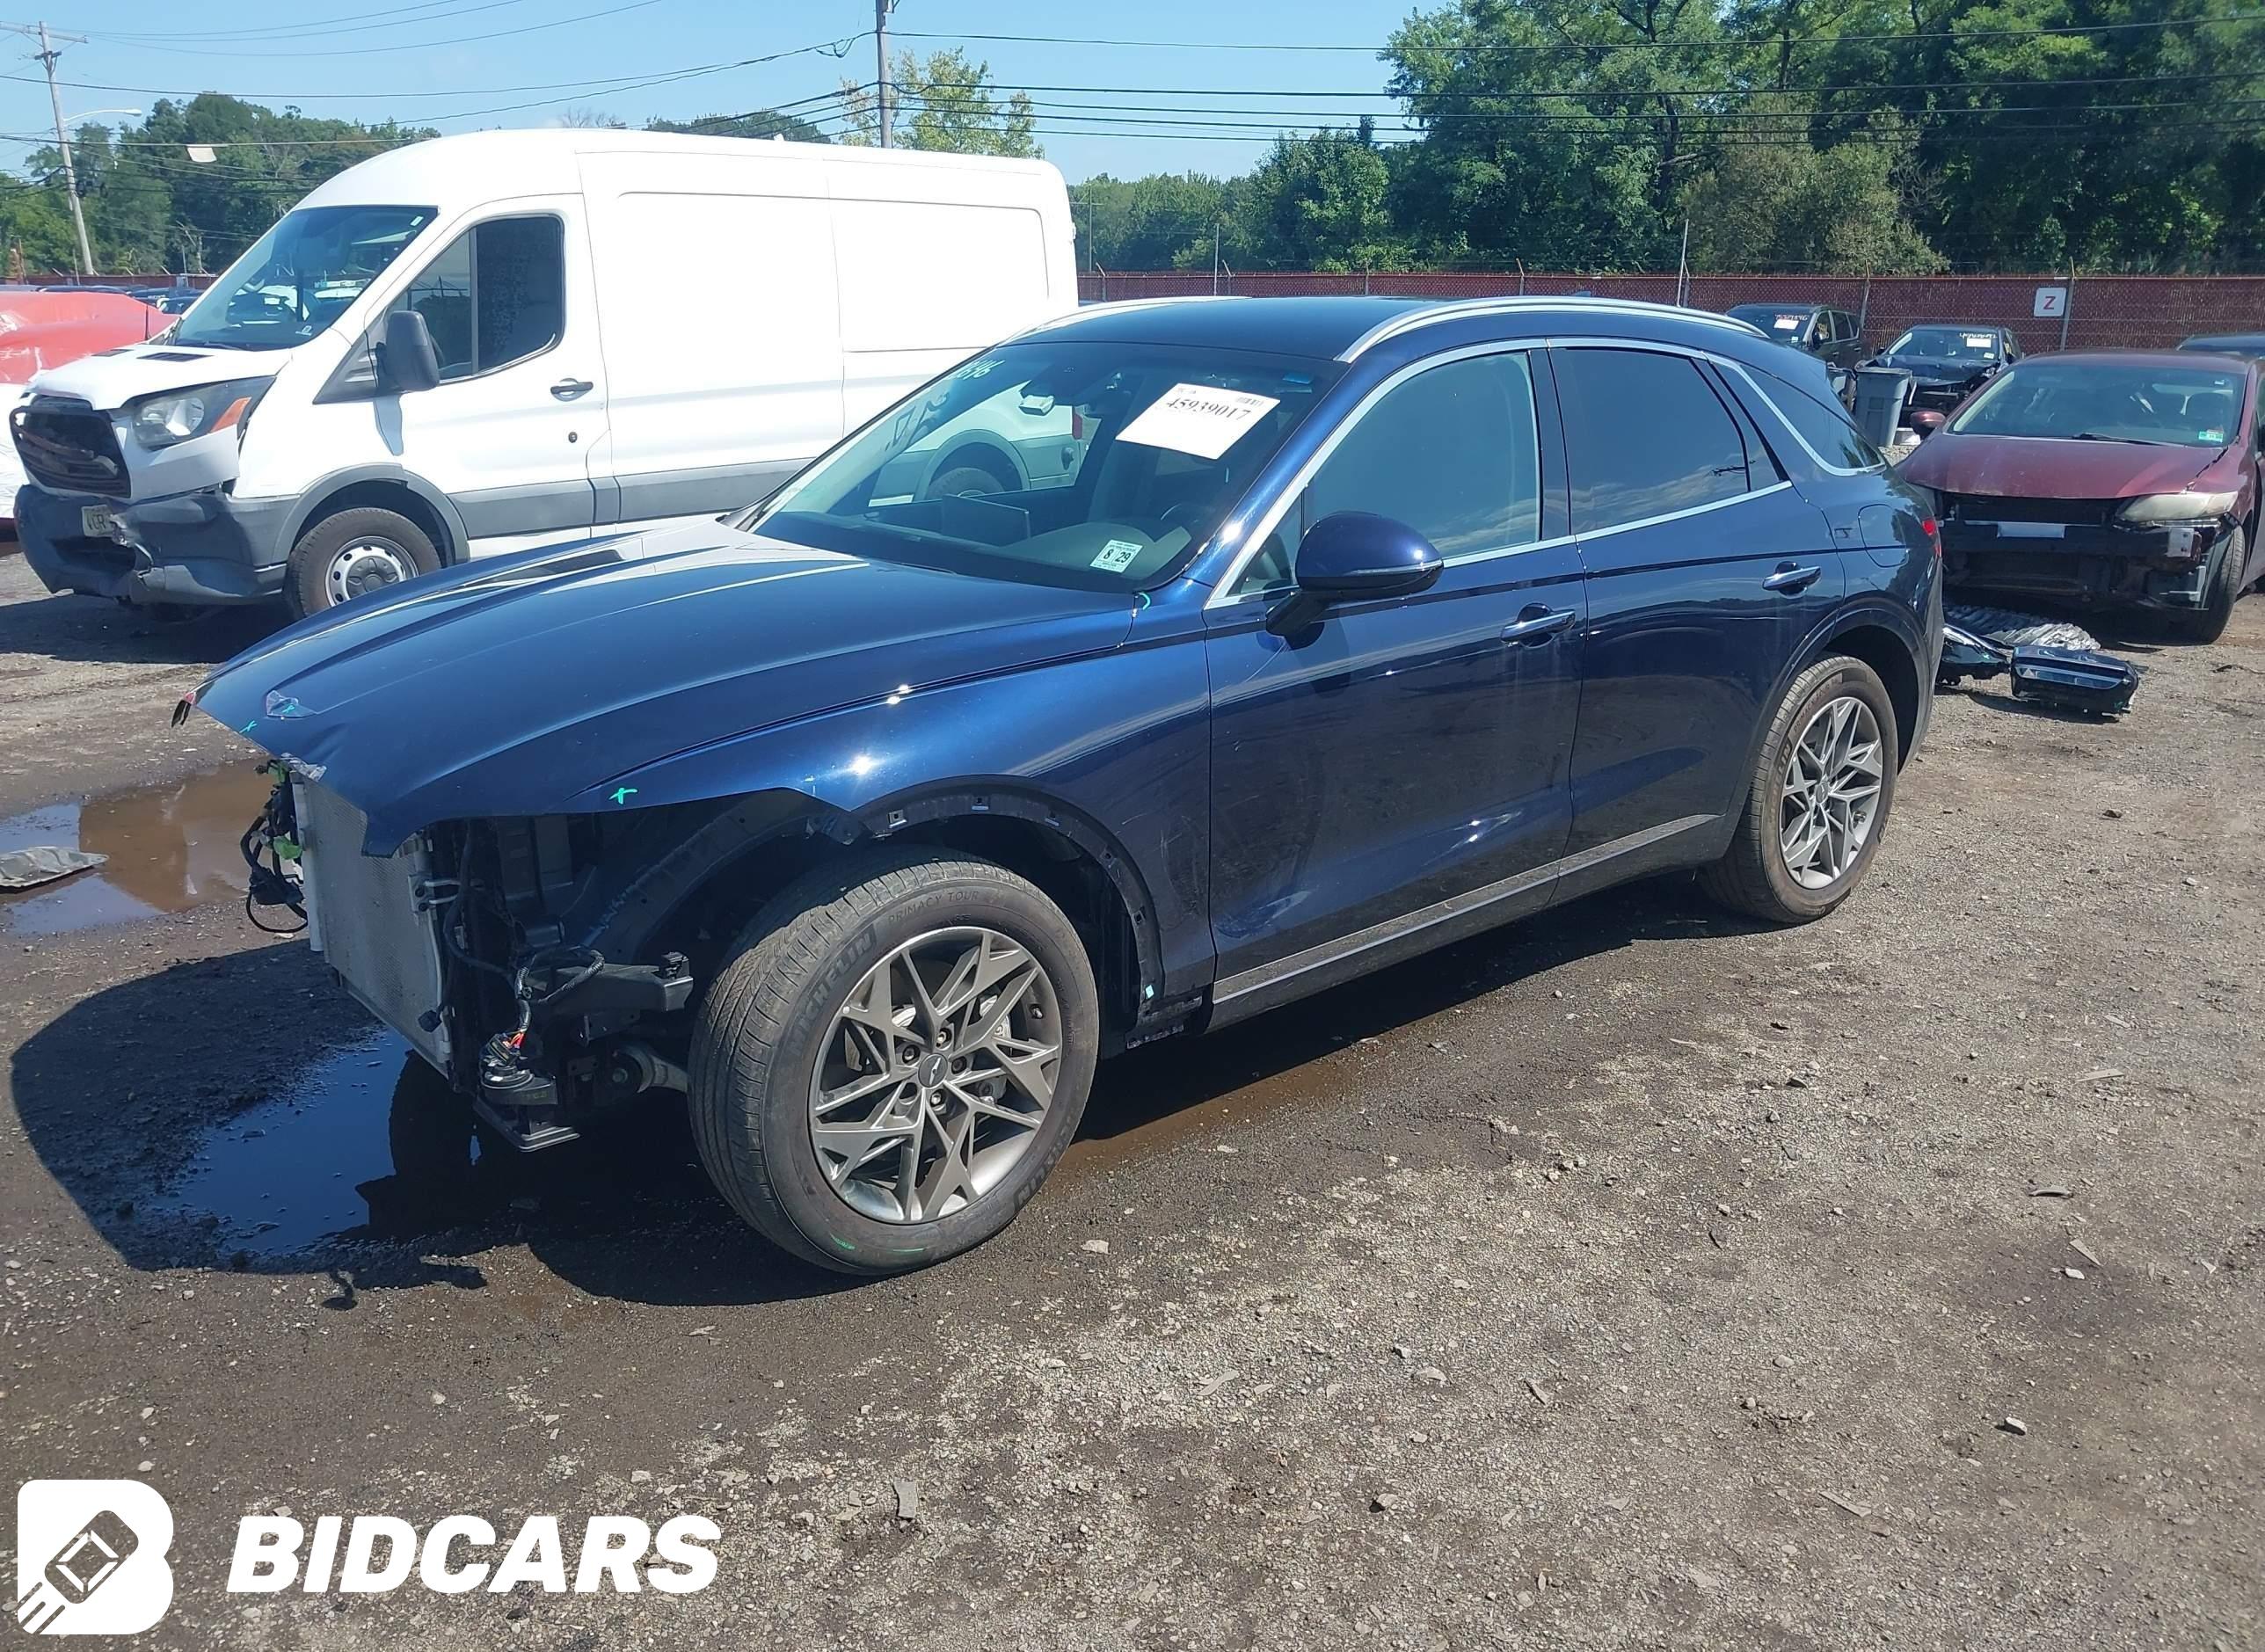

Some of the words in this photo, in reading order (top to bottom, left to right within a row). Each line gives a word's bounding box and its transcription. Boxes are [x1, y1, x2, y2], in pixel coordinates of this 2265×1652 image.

[2043, 295, 2056, 309] Z
[1167, 397, 1251, 420] 45939017
[1103, 549, 1114, 560] 8
[1115, 551, 1132, 564] 29
[888, 895, 943, 922] PRIMACY
[947, 891, 979, 901] TOUR
